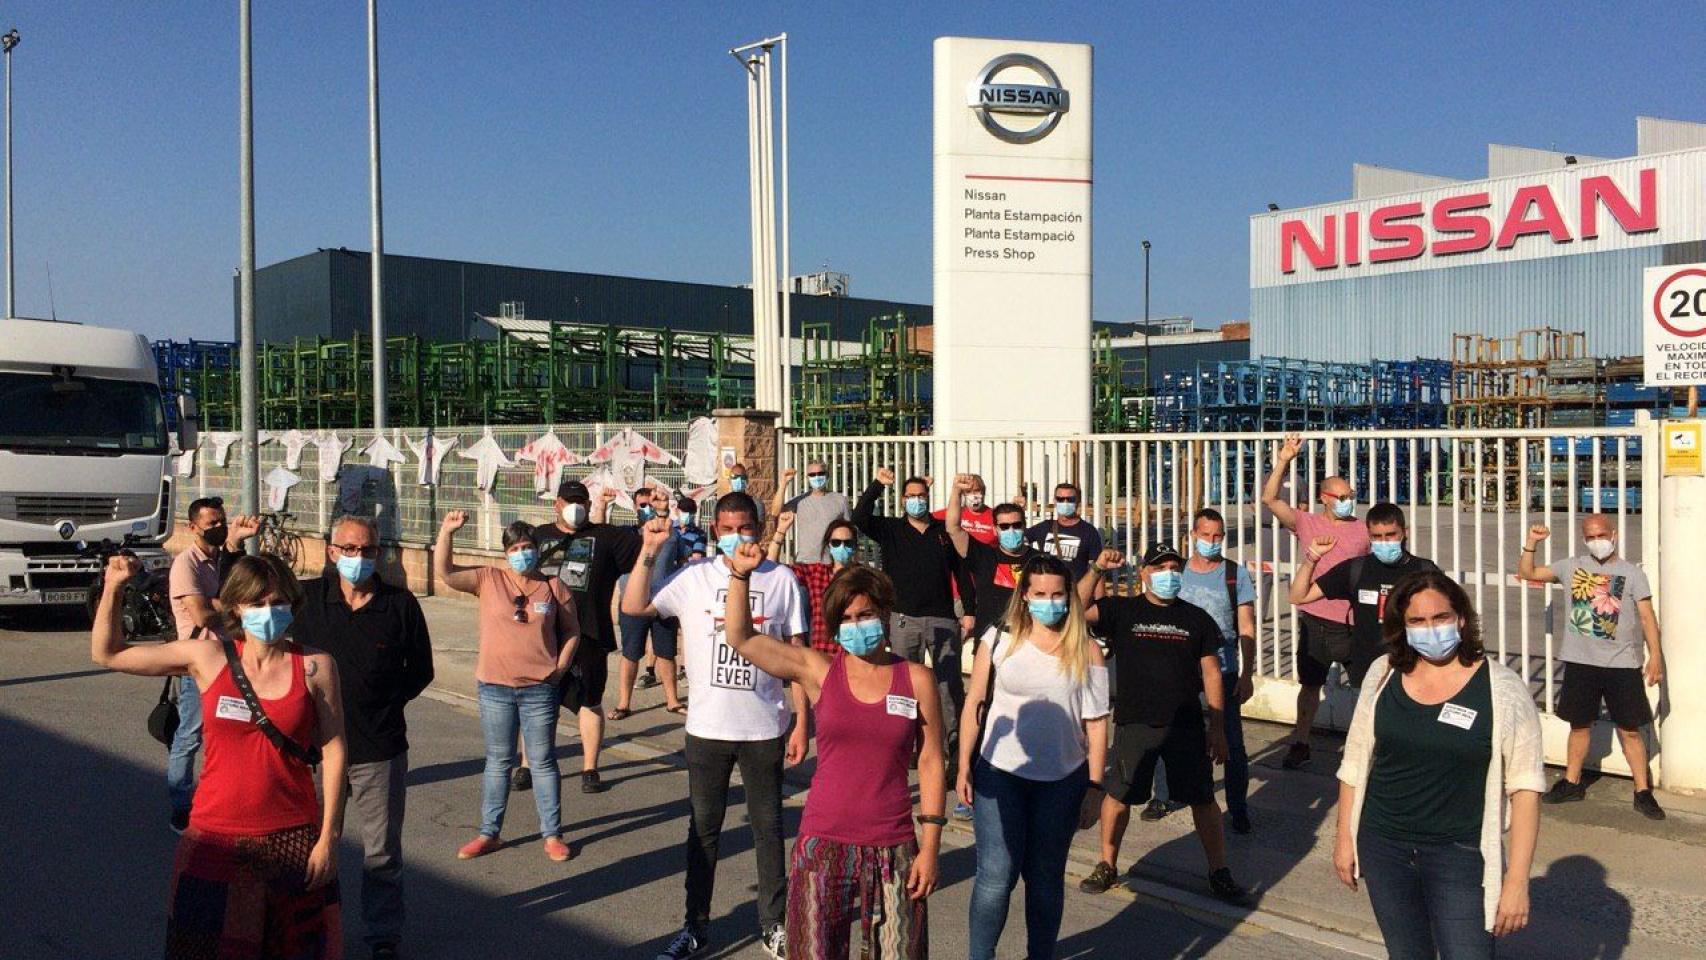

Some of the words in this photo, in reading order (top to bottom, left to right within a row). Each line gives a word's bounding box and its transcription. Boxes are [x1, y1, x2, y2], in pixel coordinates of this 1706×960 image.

[980, 88, 1060, 105] NISSAN
[964, 189, 1006, 201] Nissan
[964, 208, 1001, 220] Planta
[1004, 209, 1082, 224] Estampación
[1281, 168, 1658, 274] NISSAN
[964, 227, 1001, 240] Planta
[1004, 229, 1075, 243] Estampació
[964, 247, 999, 259] Press
[1003, 248, 1035, 261] Shop
[1670, 288, 1706, 317] 20
[1665, 362, 1680, 370] EN
[1656, 372, 1671, 380] EL
[716, 667, 751, 686] EVER
